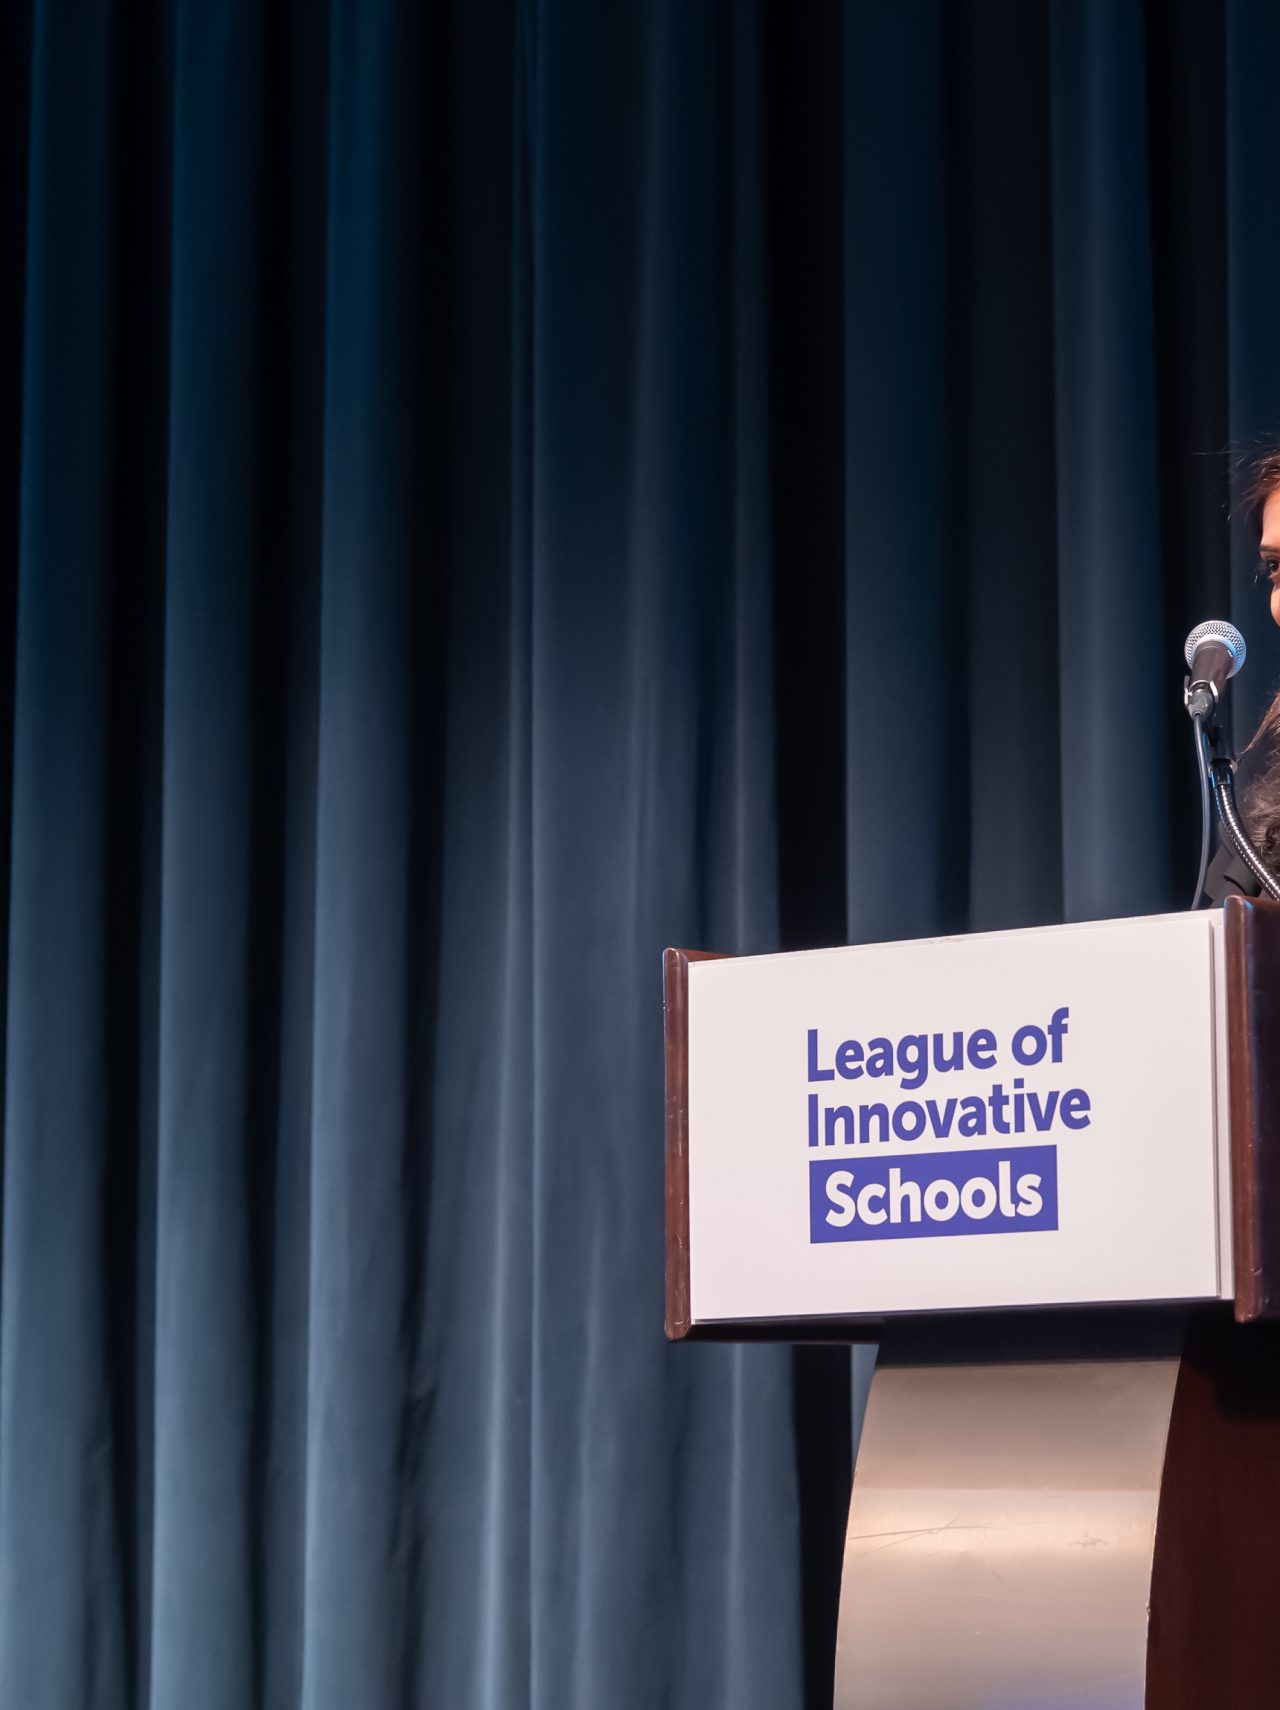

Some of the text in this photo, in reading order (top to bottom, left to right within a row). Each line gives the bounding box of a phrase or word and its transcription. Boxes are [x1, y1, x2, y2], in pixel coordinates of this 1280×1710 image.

[807, 1007, 1069, 1090] League of
[808, 1078, 1091, 1147] Innovative
[825, 1160, 1044, 1228] Schools
